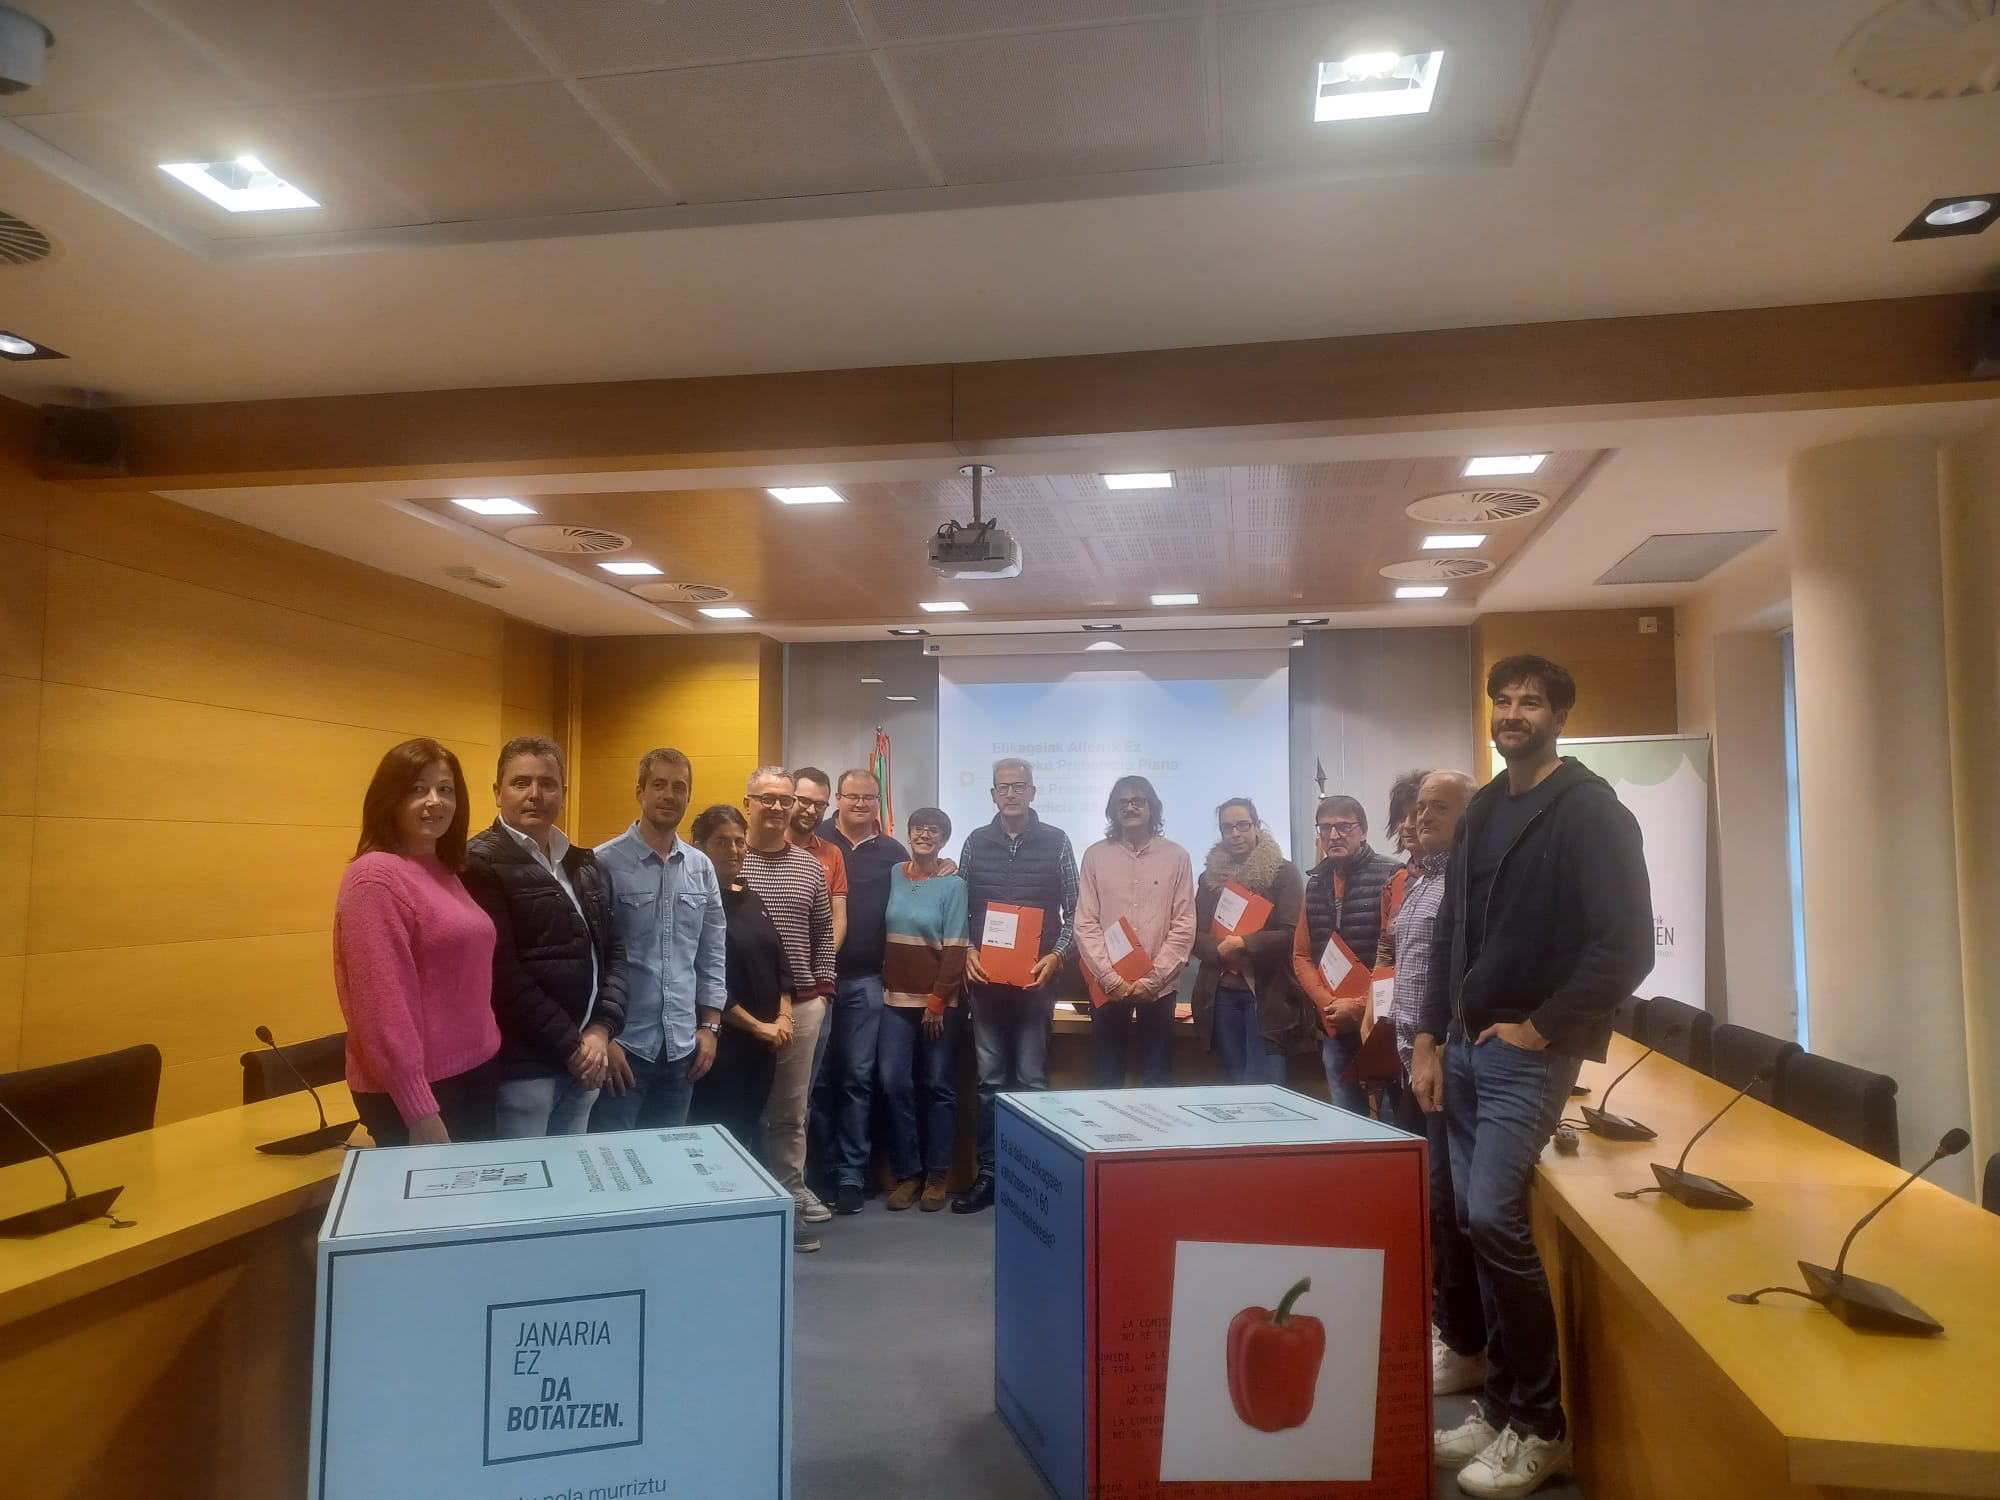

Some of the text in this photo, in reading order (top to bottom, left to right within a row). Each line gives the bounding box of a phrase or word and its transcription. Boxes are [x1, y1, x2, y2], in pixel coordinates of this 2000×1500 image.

[515, 1320, 611, 1347] JANARIA
[1139, 1318, 1169, 1328] COMID
[513, 1350, 541, 1375] EZ
[540, 1376, 572, 1402] DA
[507, 1403, 623, 1432] BOTATZEN.
[589, 1477, 666, 1500] murriztu
